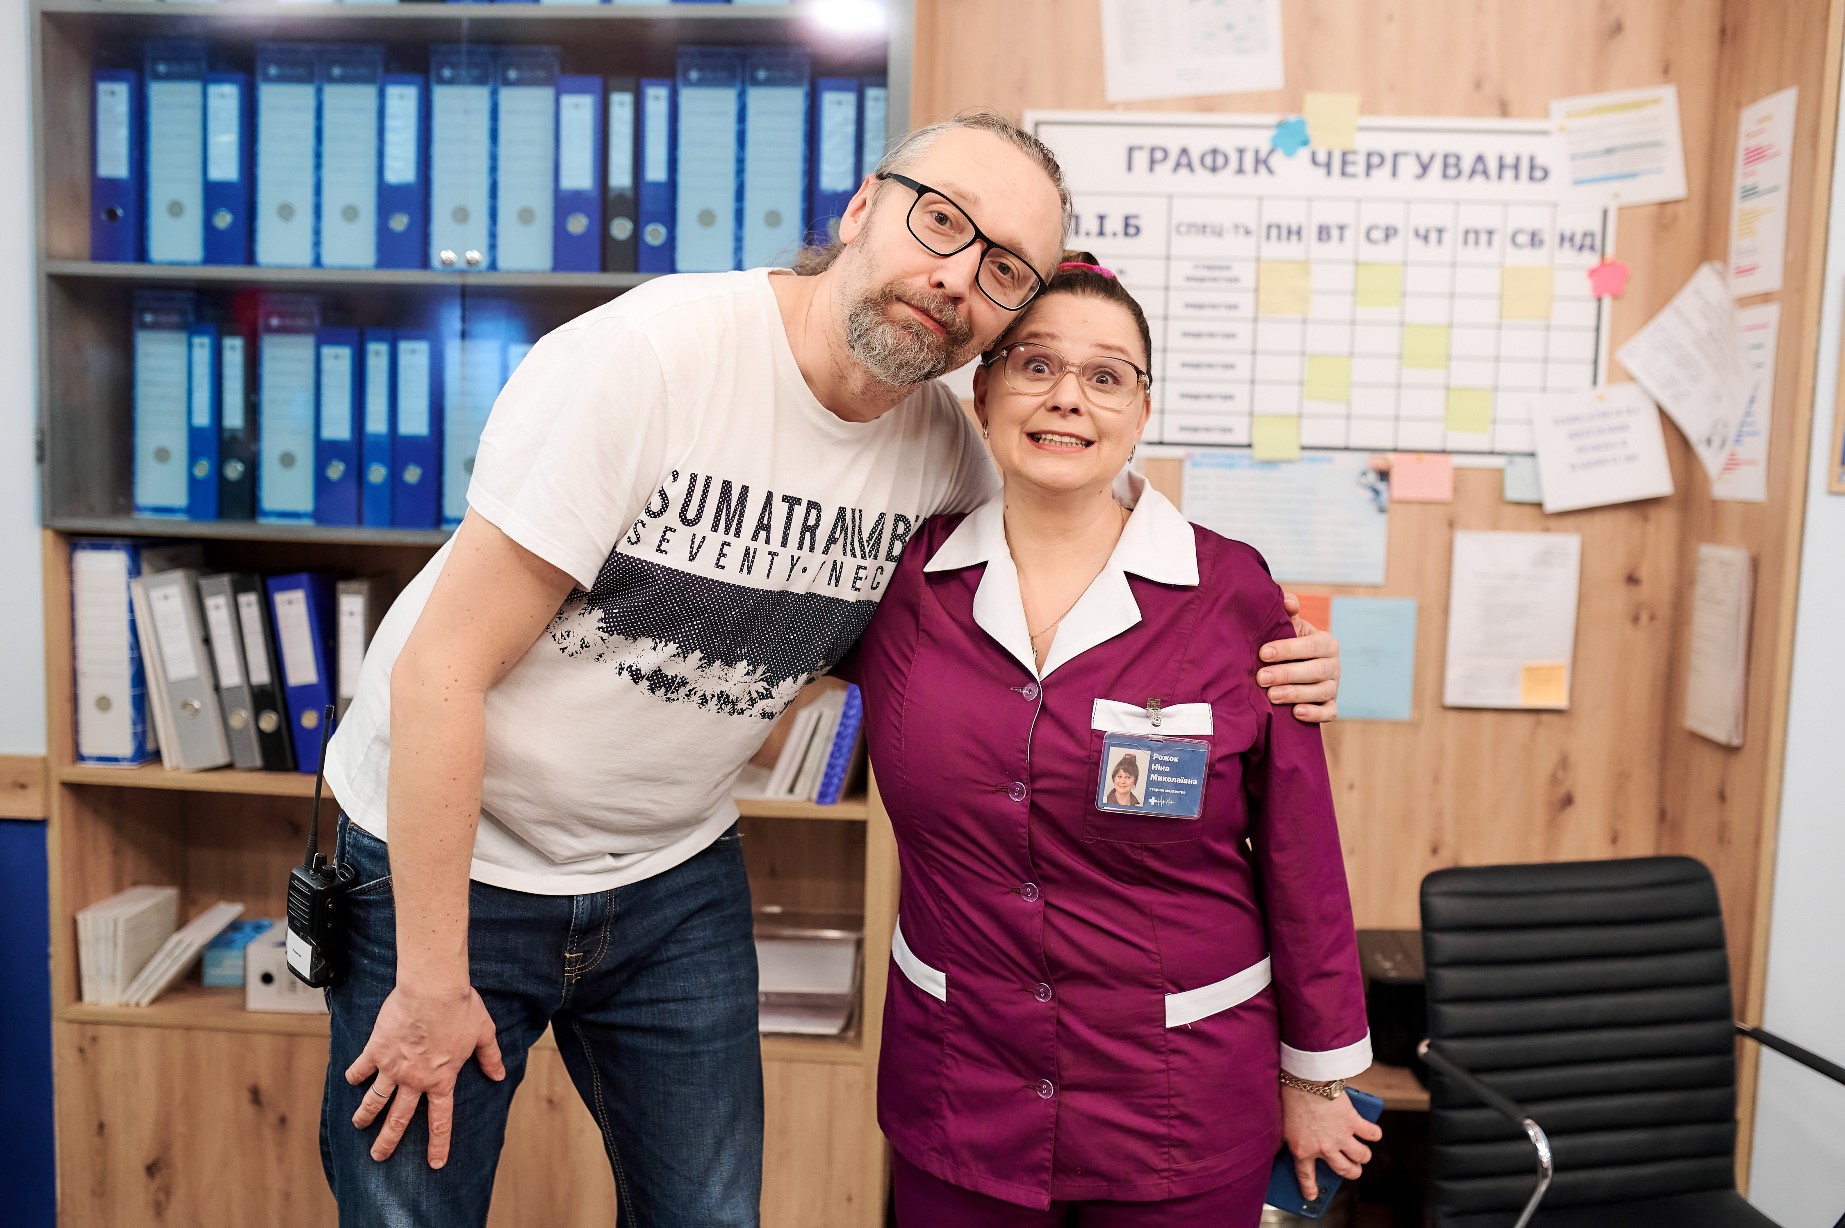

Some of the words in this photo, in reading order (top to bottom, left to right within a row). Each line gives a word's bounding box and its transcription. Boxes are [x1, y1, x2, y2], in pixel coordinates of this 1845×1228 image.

[1126, 146, 1276, 176] ГРАФІК
[1310, 148, 1551, 183] ЧЕРГУВАНЬ
[1265, 222, 1303, 243] ПН
[1316, 224, 1349, 243] ВТ
[1365, 225, 1399, 245] СР
[1413, 227, 1447, 246] ЧТ
[1462, 228, 1497, 248] ПТ
[1510, 229, 1545, 249] СБ
[1559, 231, 1599, 252] НД
[1151, 763, 1170, 772] Ніна
[1152, 753, 1179, 762] Рожок
[1149, 774, 1198, 784] Миколаївна
